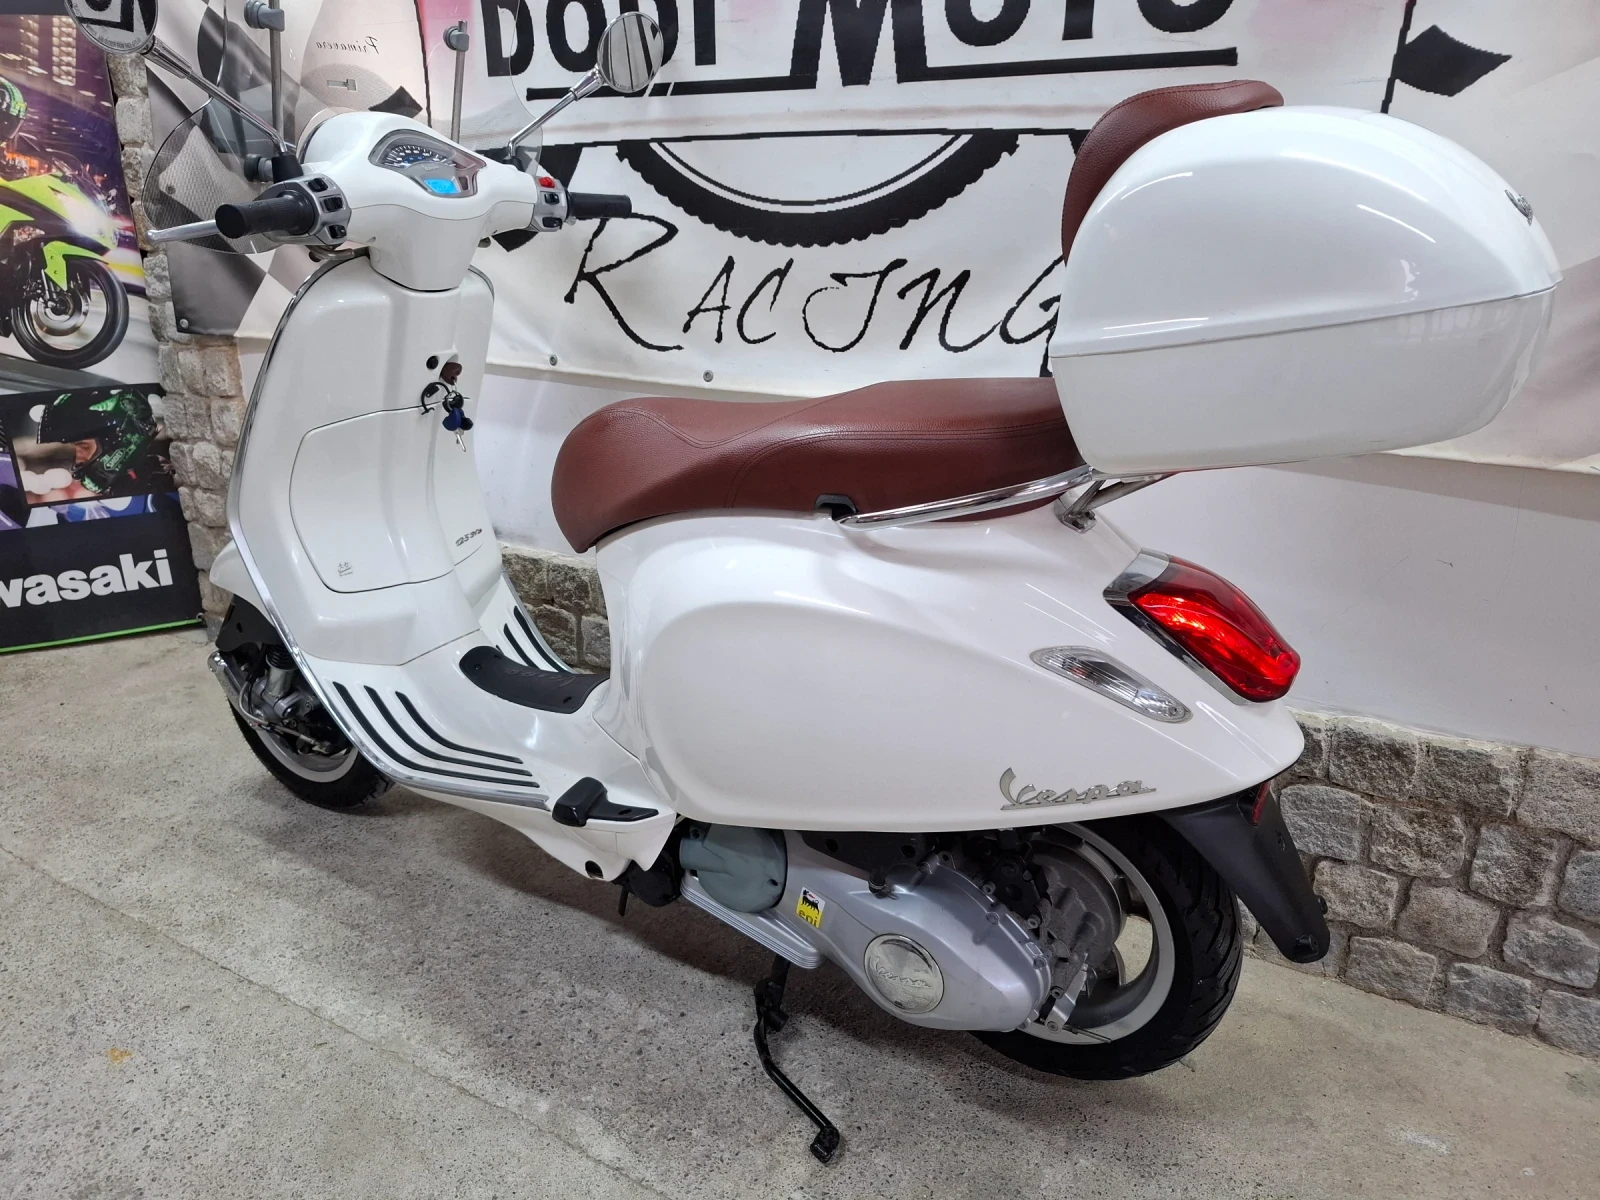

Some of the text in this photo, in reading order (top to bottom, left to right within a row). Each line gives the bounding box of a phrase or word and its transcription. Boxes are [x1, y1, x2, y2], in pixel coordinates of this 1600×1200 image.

[999, 767, 1157, 811] Vespa
[798, 908, 820, 928] eni
[873, 956, 933, 989] Vespa
